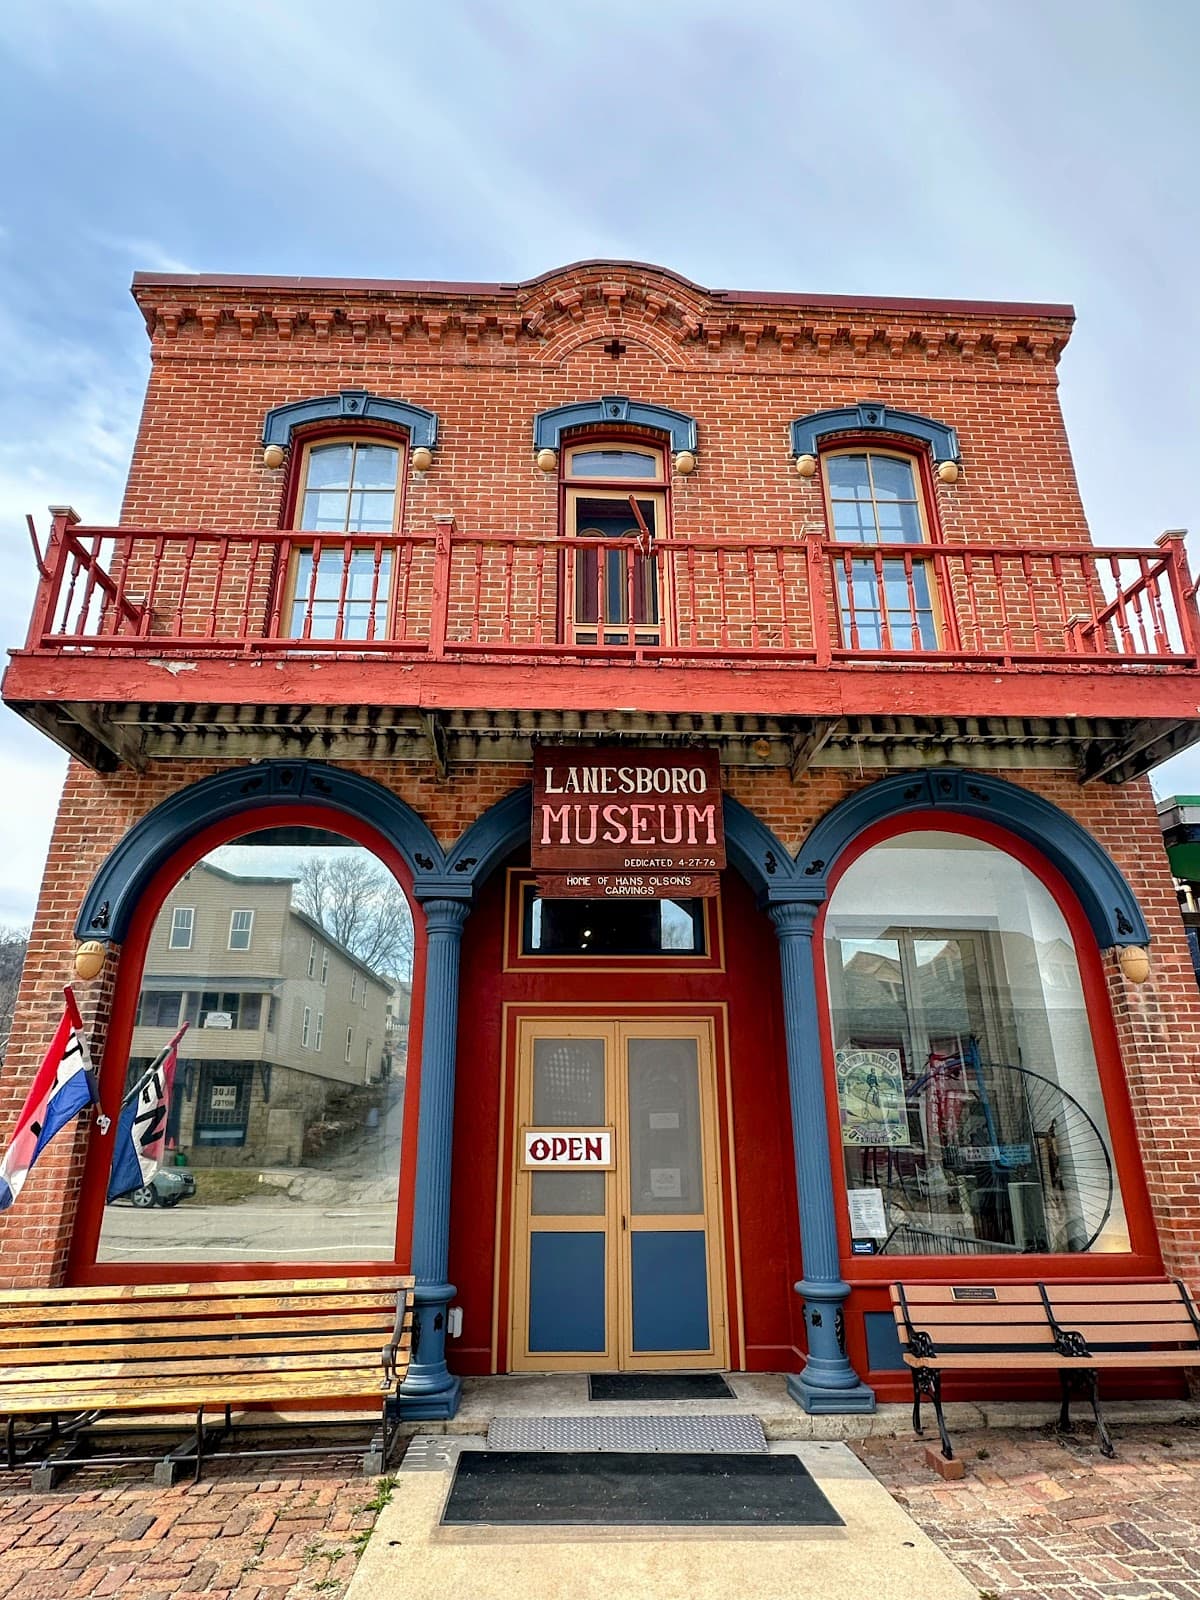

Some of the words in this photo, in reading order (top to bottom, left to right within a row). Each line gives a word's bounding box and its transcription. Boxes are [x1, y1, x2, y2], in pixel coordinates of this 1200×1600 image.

[544, 767, 707, 794] LANESBORO
[540, 804, 717, 845] MUSEUM
[624, 858, 673, 868] DEDICATED
[678, 858, 716, 867] 4-27-76
[566, 876, 591, 886] HOME
[597, 876, 609, 885] OF
[615, 876, 644, 886] HANS
[648, 875, 692, 886] OLSON'S
[604, 886, 655, 895] CARVINGS
[528, 1136, 603, 1161] OPEN
